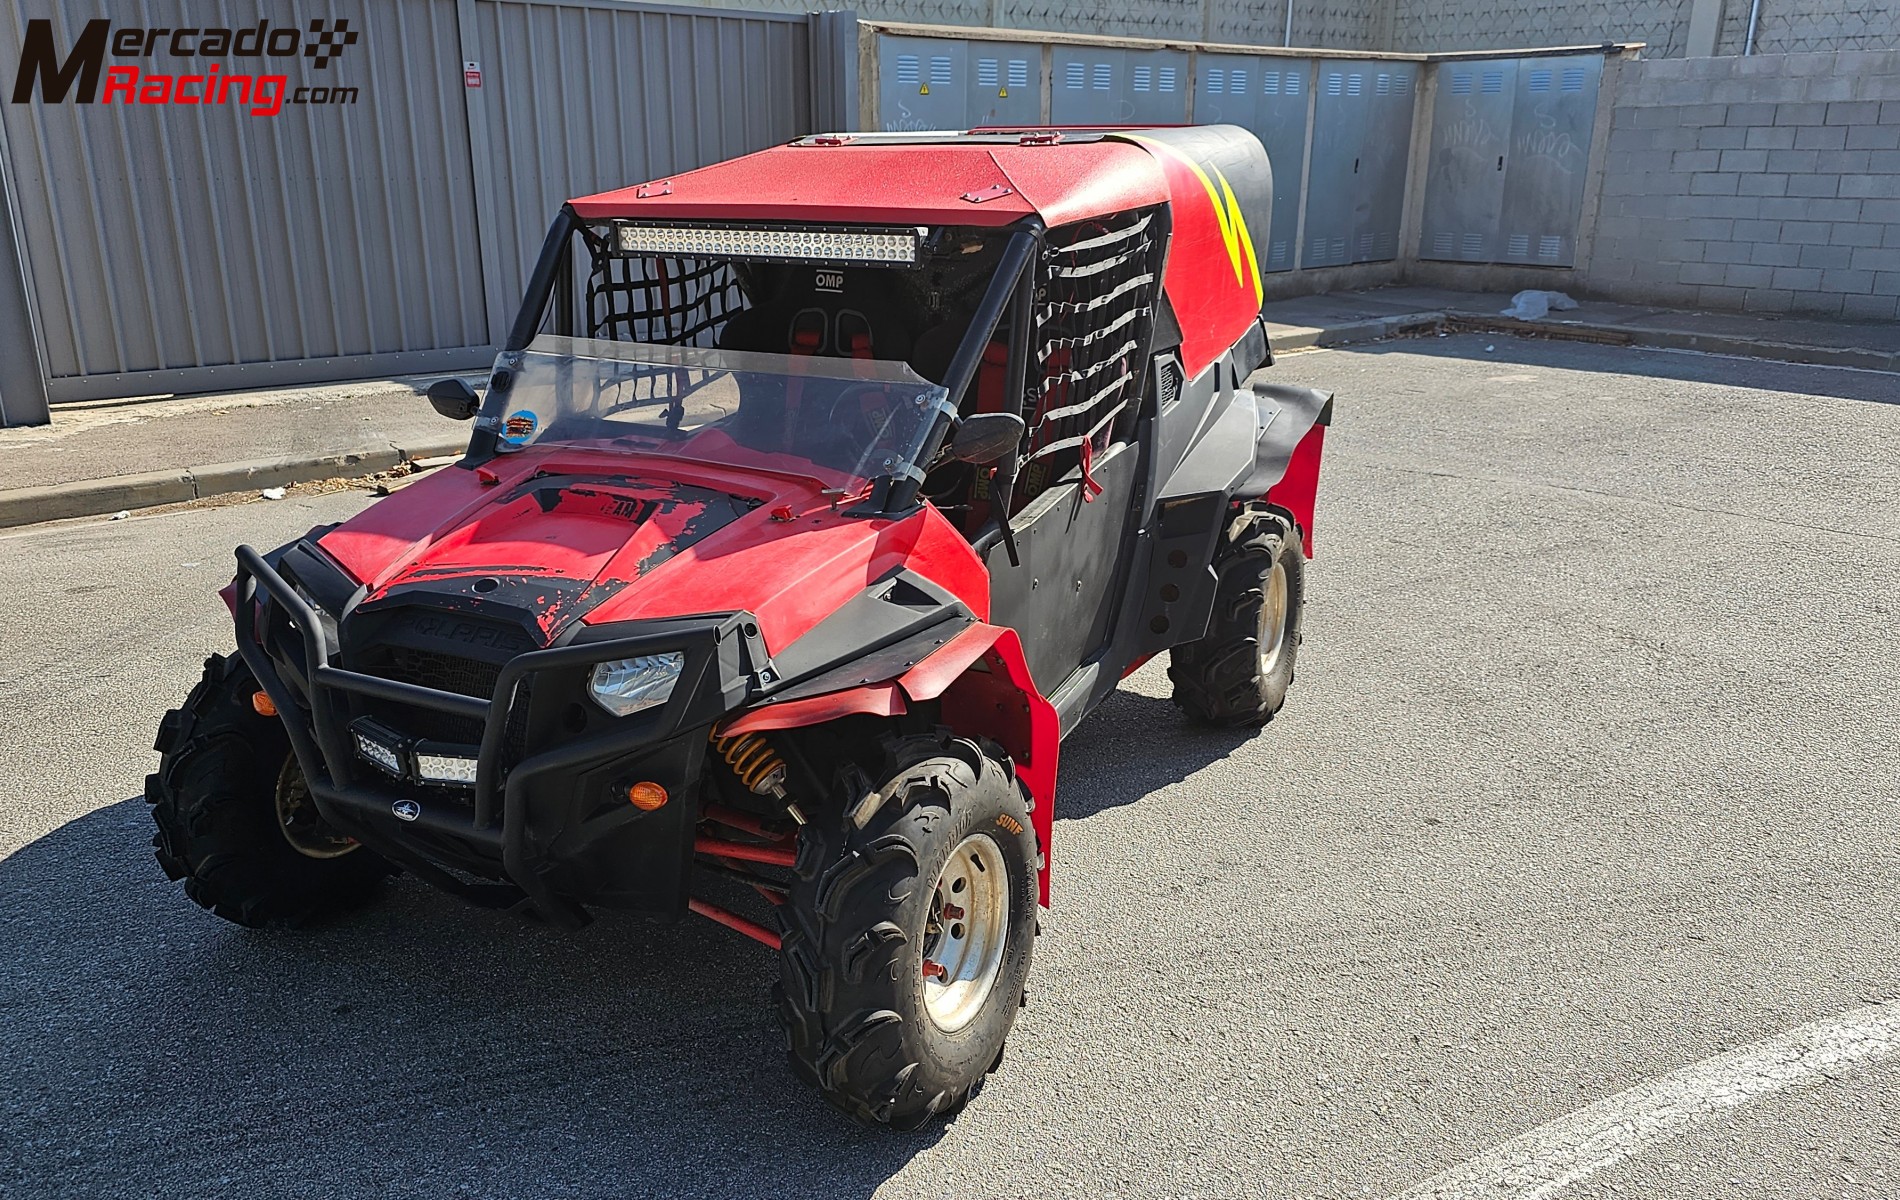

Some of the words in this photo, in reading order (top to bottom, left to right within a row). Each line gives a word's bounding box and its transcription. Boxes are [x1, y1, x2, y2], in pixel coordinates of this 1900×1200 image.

[815, 274, 844, 288] OMP
[1028, 463, 1042, 496] OMP
[995, 813, 1025, 836] SUNF
